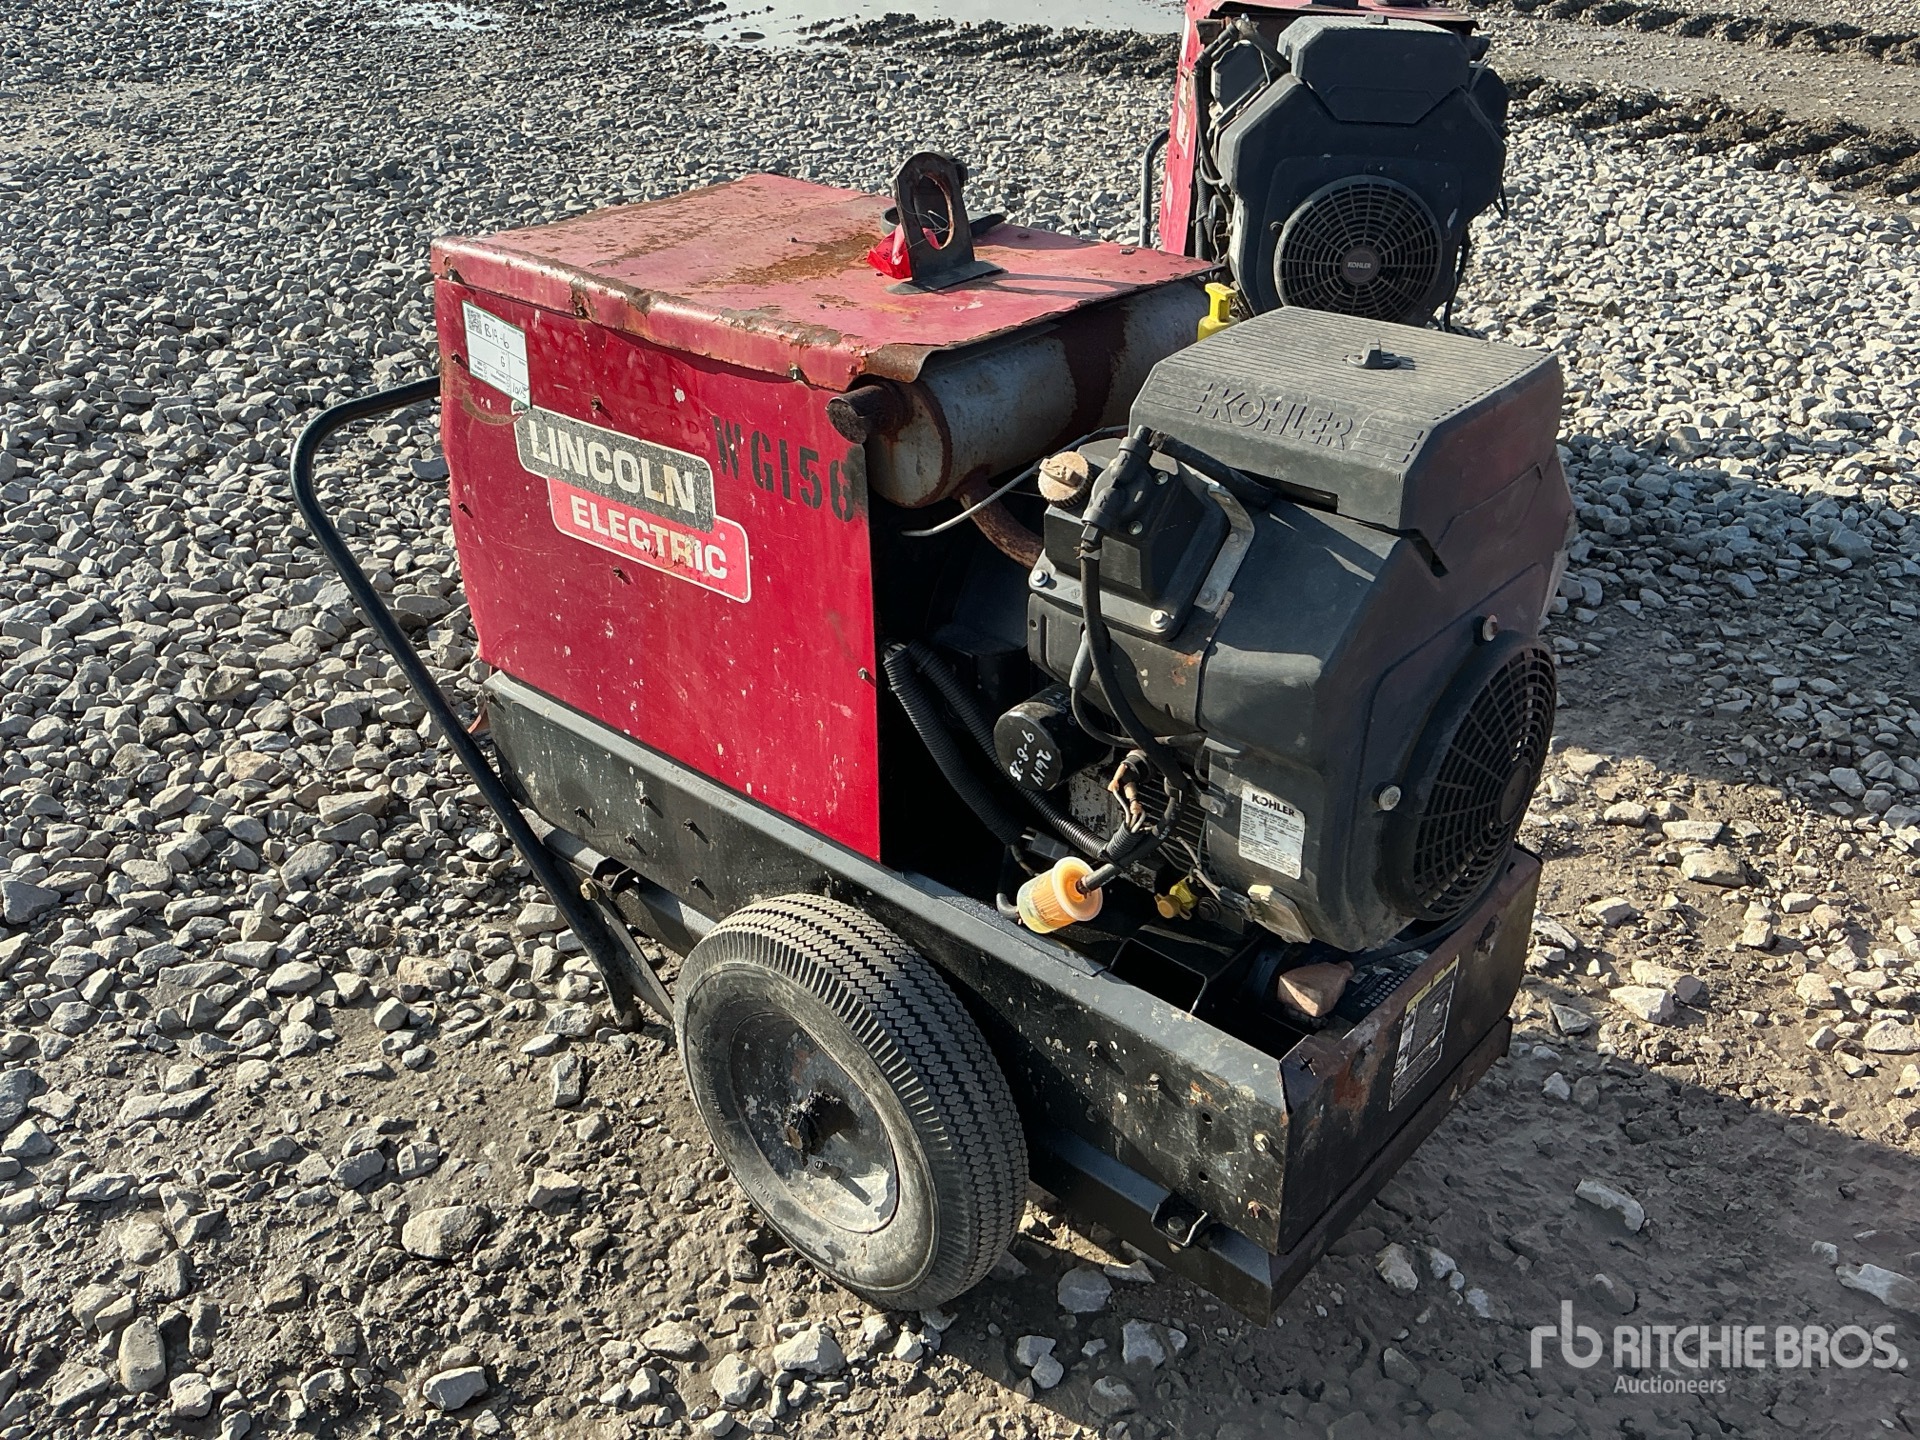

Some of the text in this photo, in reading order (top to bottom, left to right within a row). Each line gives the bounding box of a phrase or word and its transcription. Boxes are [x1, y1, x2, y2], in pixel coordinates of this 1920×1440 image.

[1347, 261, 1372, 269] KOHLER
[1204, 386, 1354, 451] KOHLER
[528, 419, 697, 514] LINCOLN
[570, 494, 728, 580] ELECTRIC
[1251, 793, 1295, 817] KOHLER
